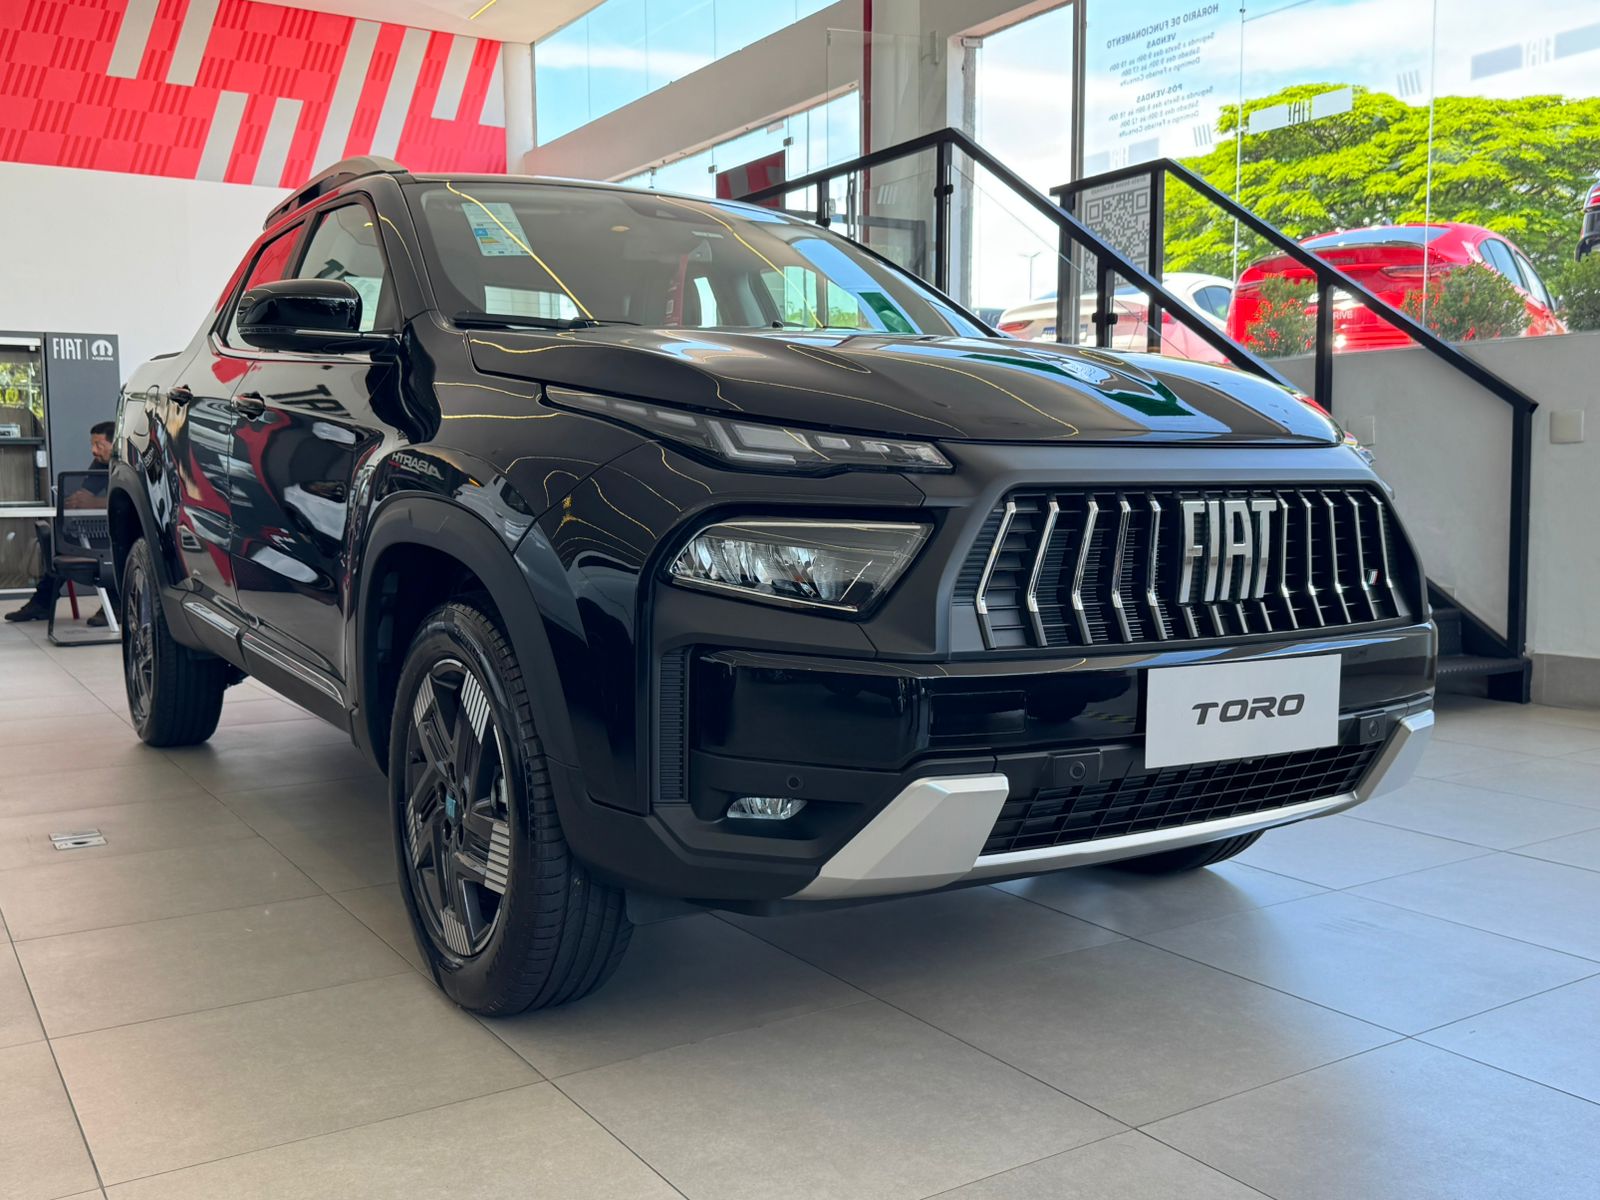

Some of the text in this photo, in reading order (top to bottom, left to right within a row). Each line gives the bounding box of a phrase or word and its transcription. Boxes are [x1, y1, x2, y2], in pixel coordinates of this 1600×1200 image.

[1333, 310, 1353, 321] RIVE
[52, 337, 82, 360] FIAT
[1179, 500, 1277, 604] FIAT
[1192, 693, 1305, 726] TORO
